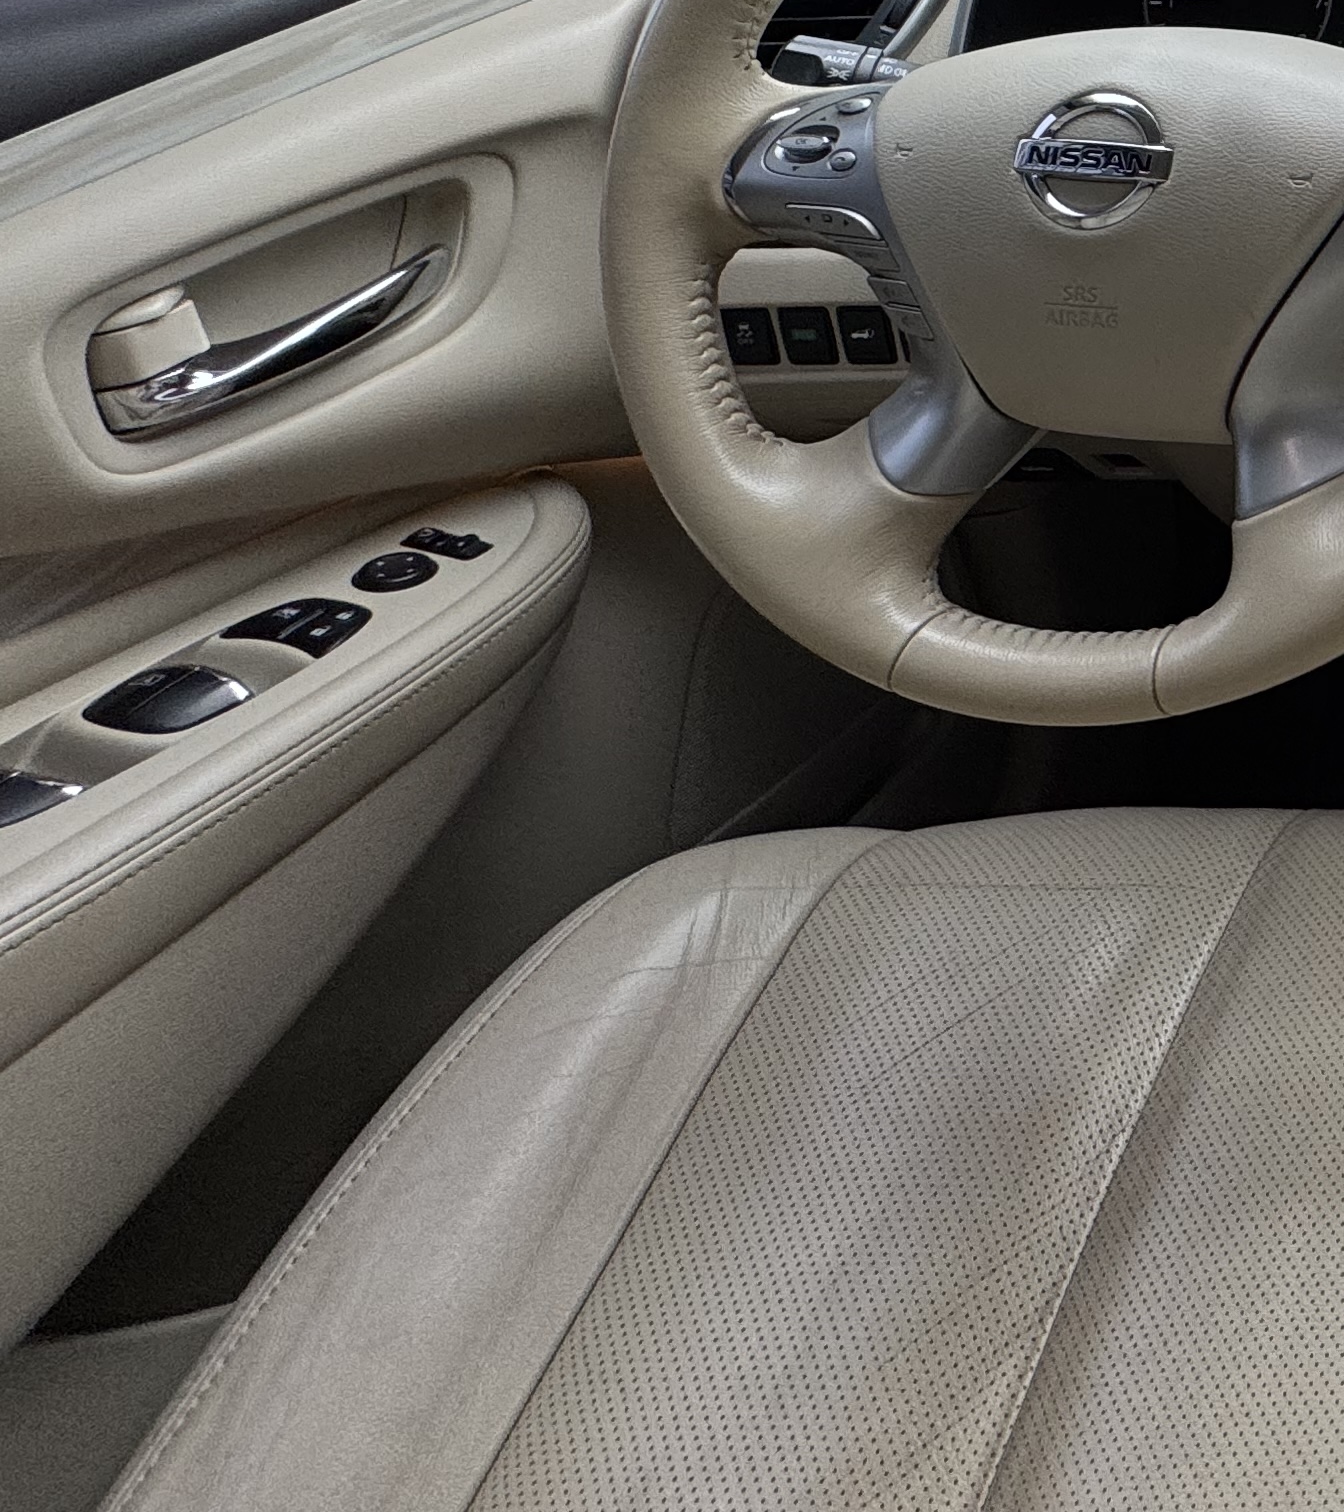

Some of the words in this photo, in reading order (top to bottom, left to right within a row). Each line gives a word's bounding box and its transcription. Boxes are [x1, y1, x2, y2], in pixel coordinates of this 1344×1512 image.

[824, 53, 856, 67] AUTO
[1026, 144, 1153, 174] NISSAN
[1062, 286, 1099, 303] SRS
[1043, 310, 1120, 329] AIRBAG
